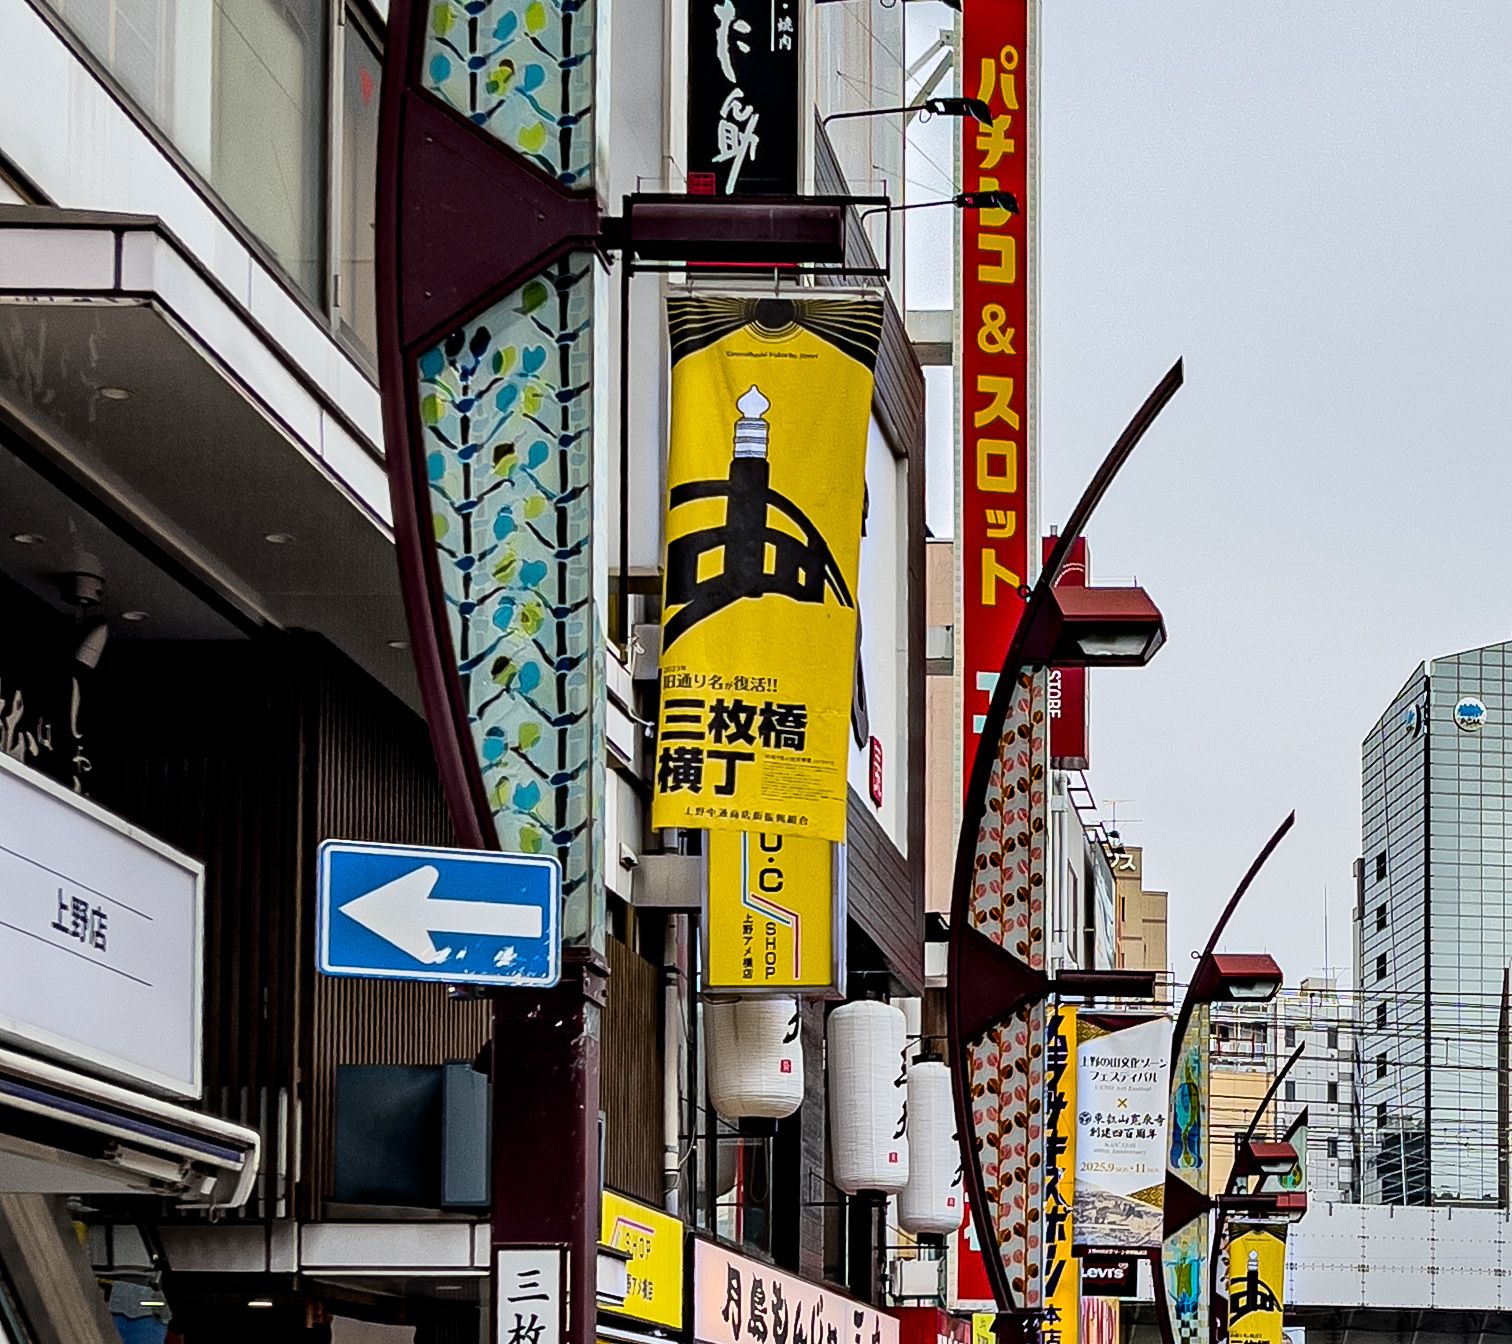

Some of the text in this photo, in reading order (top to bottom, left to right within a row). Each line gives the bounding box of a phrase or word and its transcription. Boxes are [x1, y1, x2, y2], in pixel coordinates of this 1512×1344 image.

[977, 304, 1016, 355] &
[974, 374, 1020, 606] スロット
[1048, 669, 1062, 719] STORE
[661, 698, 808, 752] 三枚橋
[658, 746, 755, 796] 横丁
[51, 886, 109, 953] 上野店
[765, 921, 777, 980] SHOP
[1089, 1070, 1158, 1083] フェスティバル
